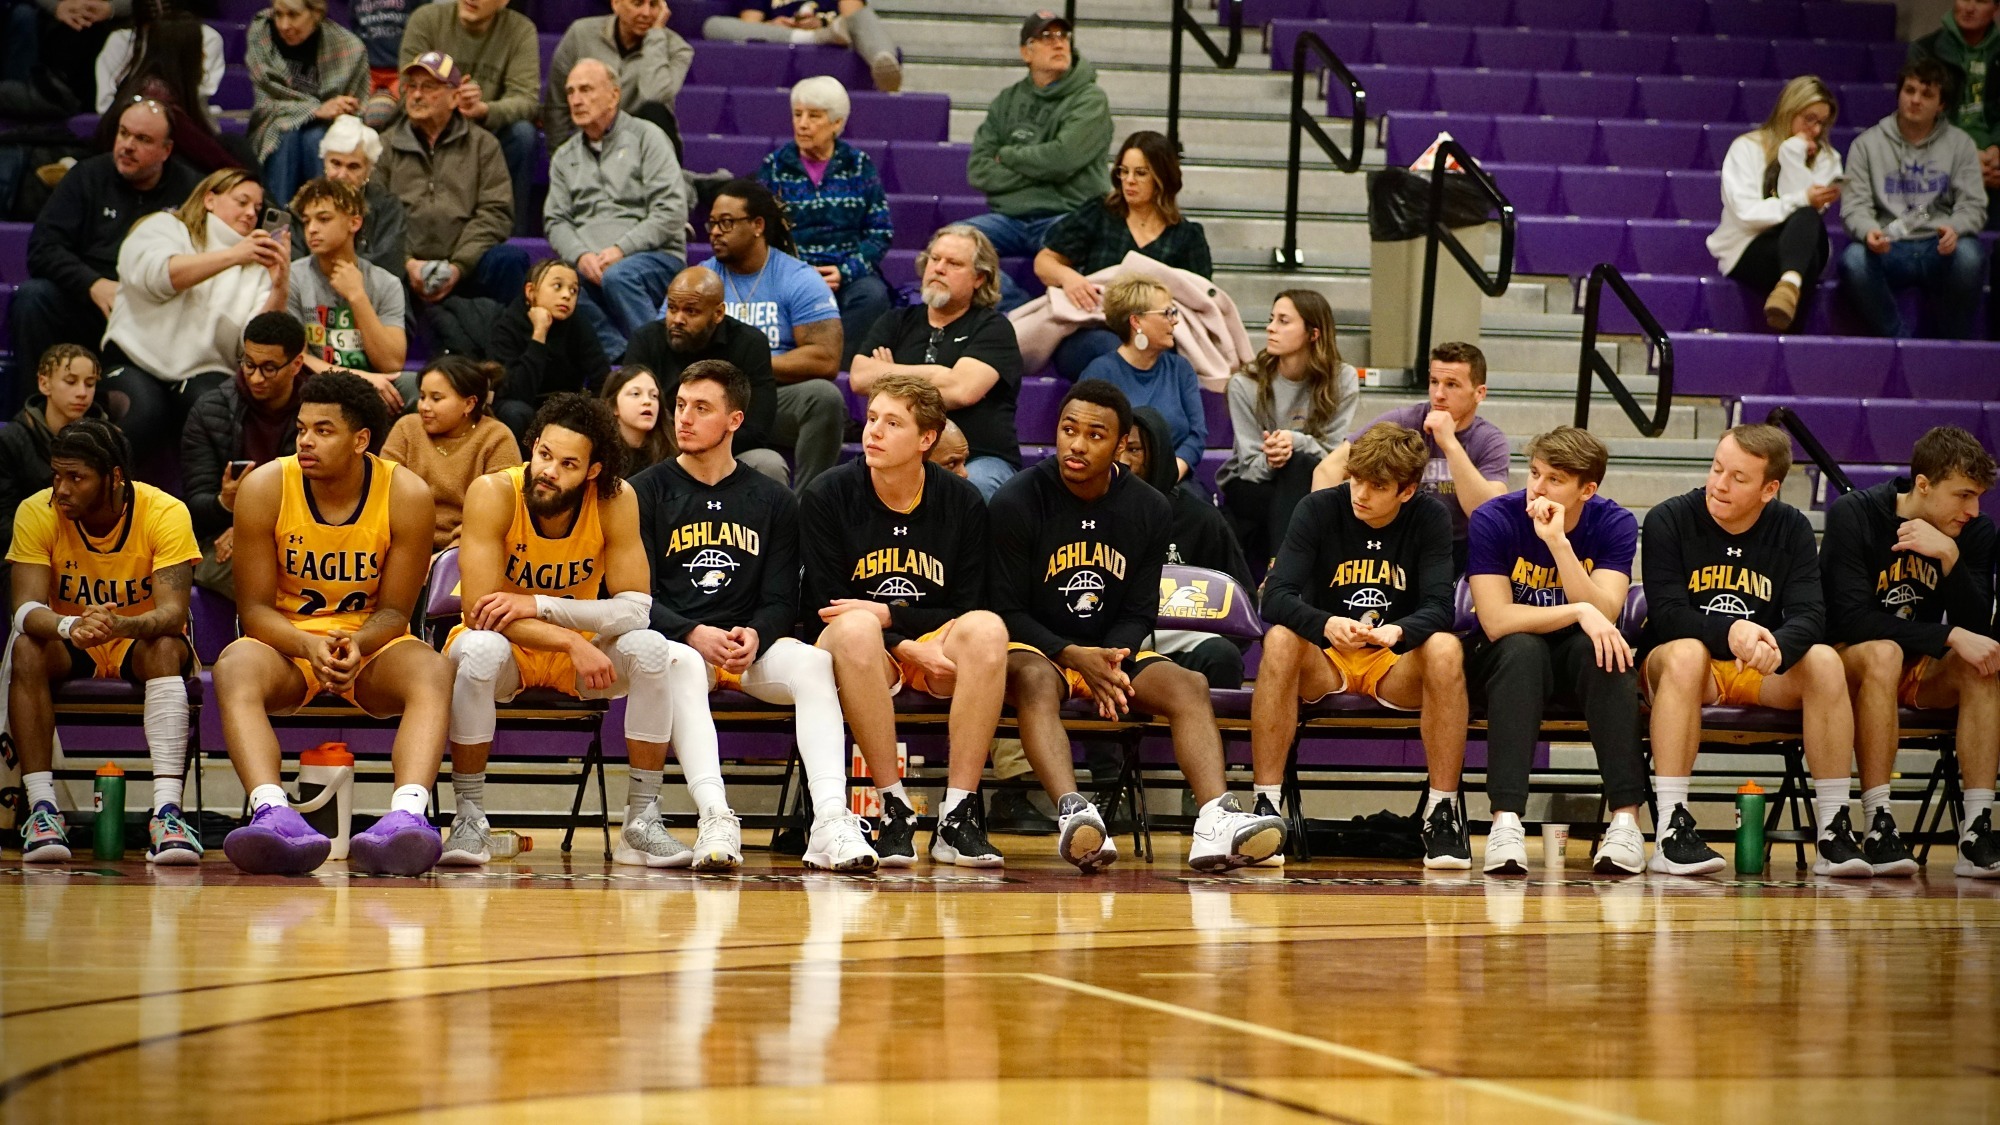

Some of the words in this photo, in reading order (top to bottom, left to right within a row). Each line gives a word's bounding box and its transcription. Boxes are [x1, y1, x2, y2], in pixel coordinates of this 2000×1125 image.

[665, 521, 760, 557] ASHLAND
[285, 548, 380, 582] EAGLES
[505, 554, 595, 590] EAGLES
[851, 547, 945, 587] ASHLAND
[1044, 541, 1127, 583] ASHLAND
[58, 574, 153, 608] EAGLES
[1688, 565, 1773, 602] ASHLAND
[1158, 604, 1219, 619] EAGLES
